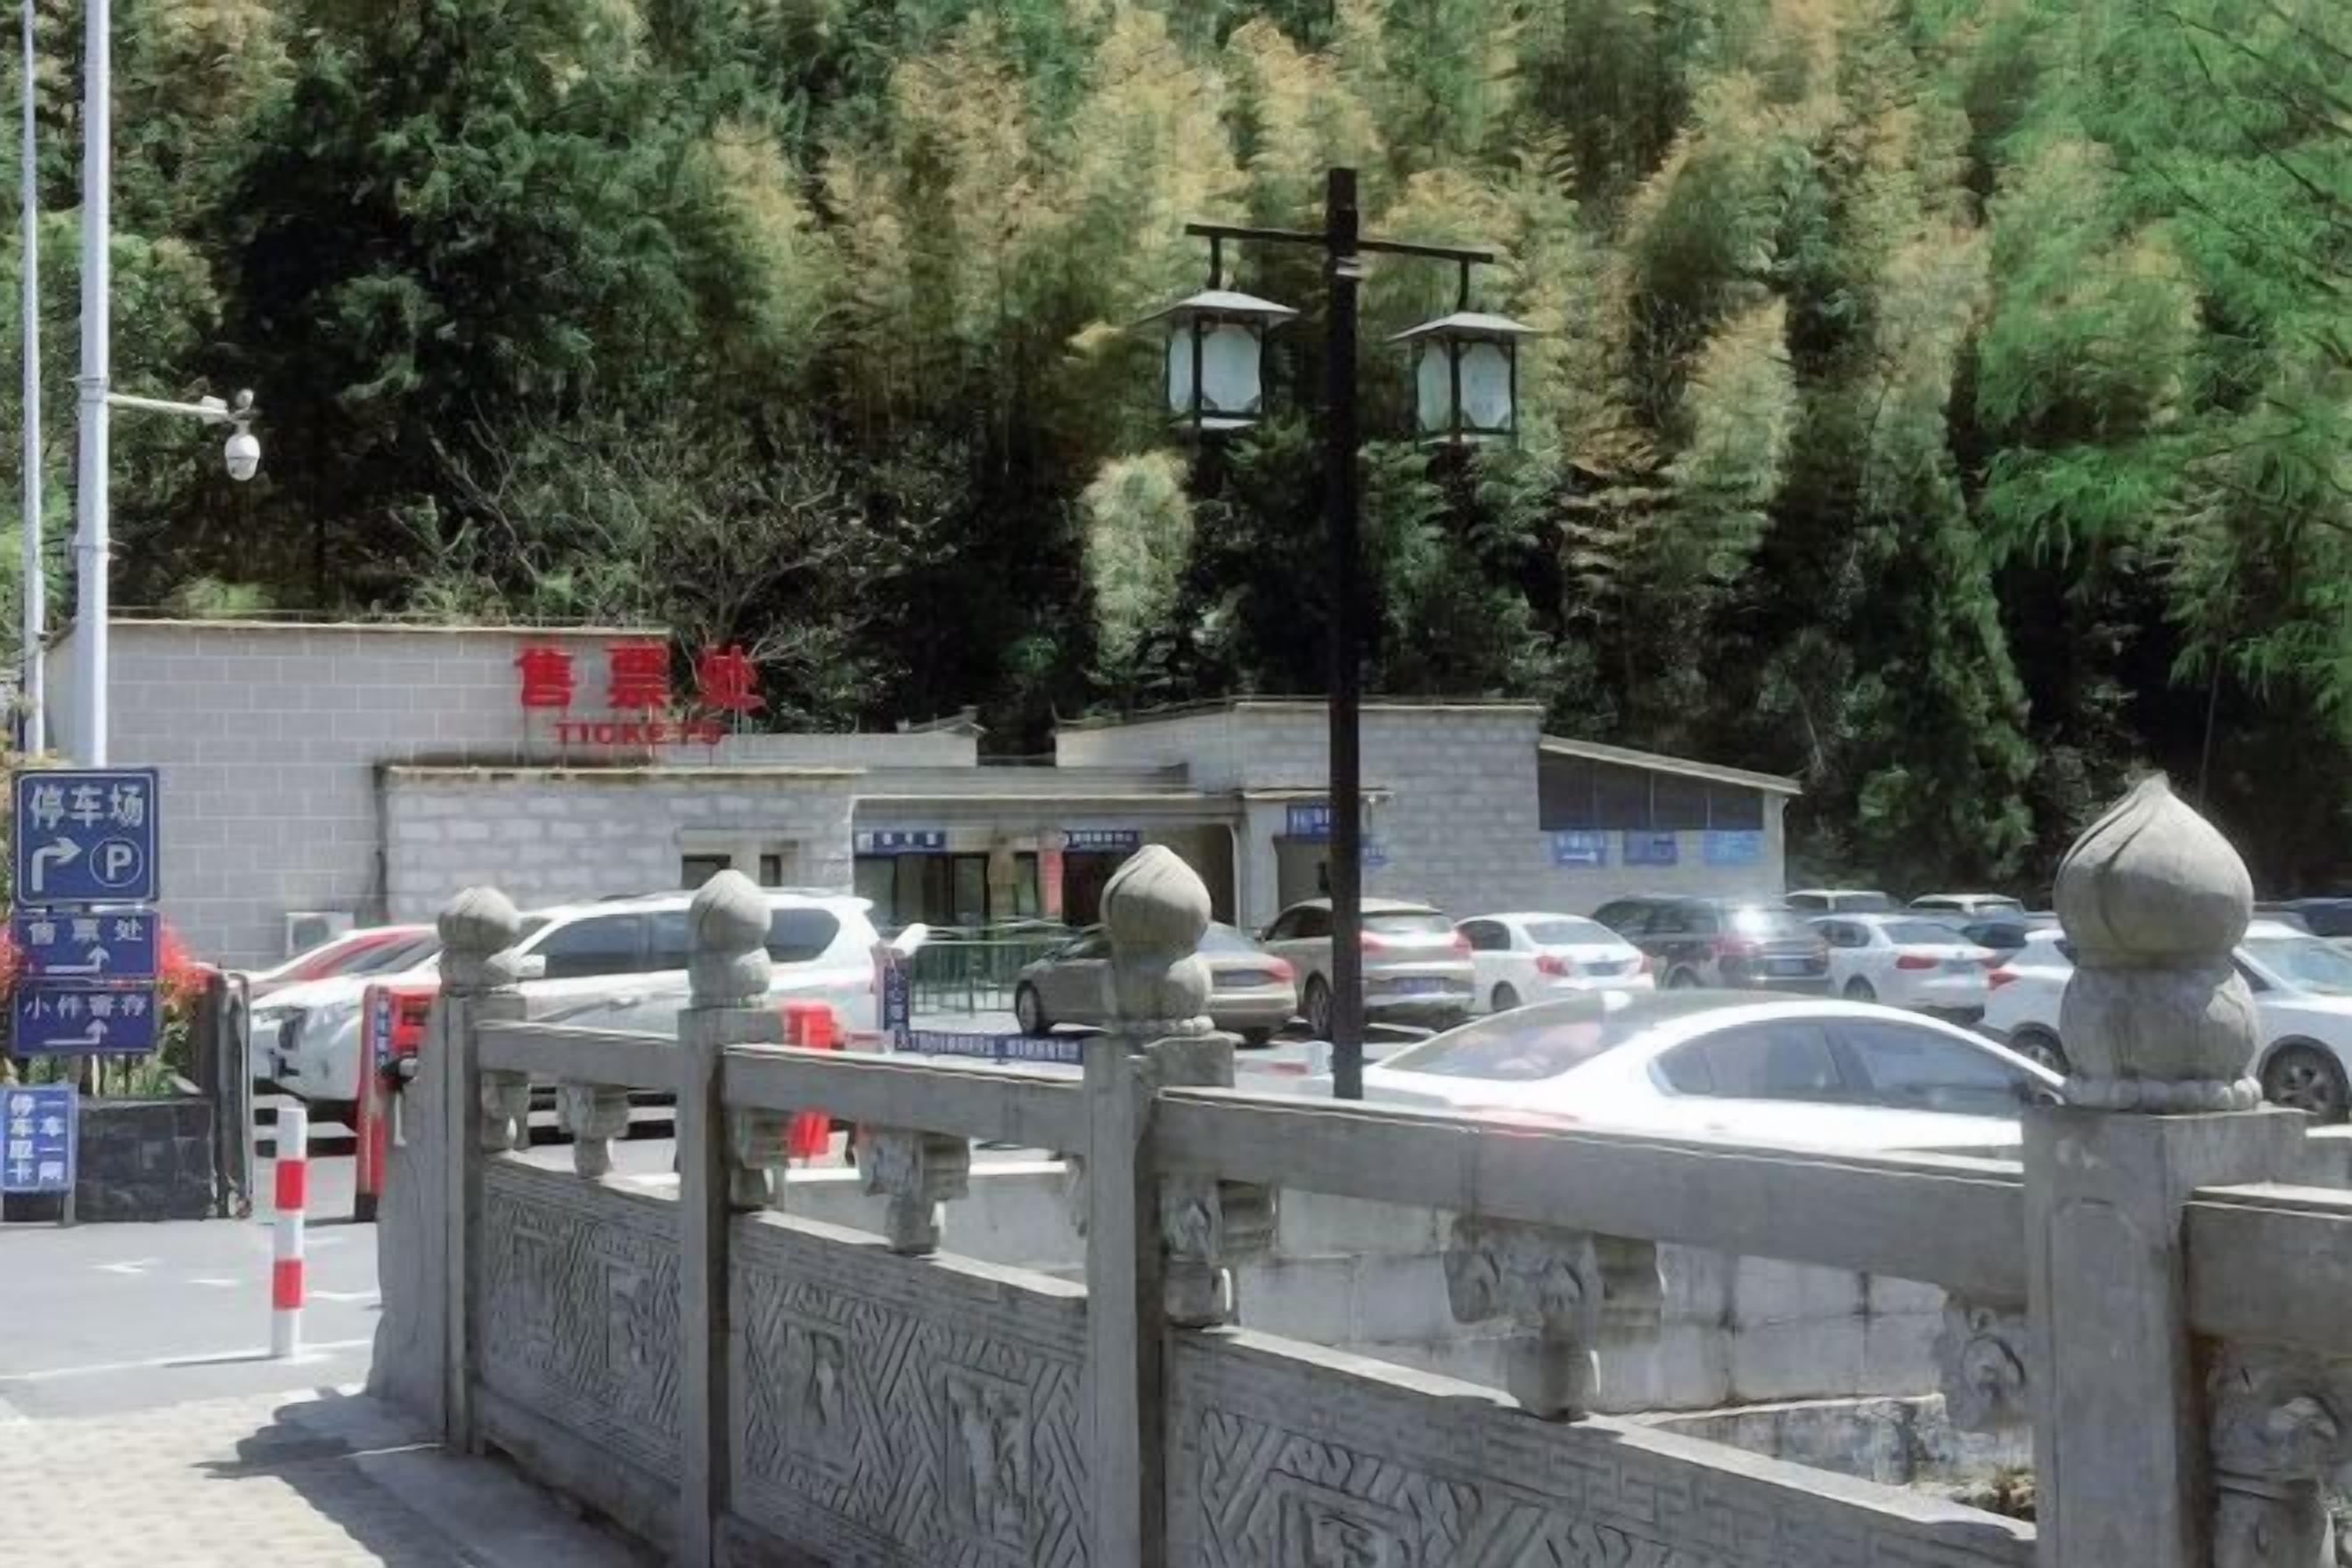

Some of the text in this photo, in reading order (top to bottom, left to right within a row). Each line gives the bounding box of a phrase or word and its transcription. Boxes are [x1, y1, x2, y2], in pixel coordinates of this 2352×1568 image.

[29, 783, 144, 829] 停车场
[106, 845, 132, 880] P
